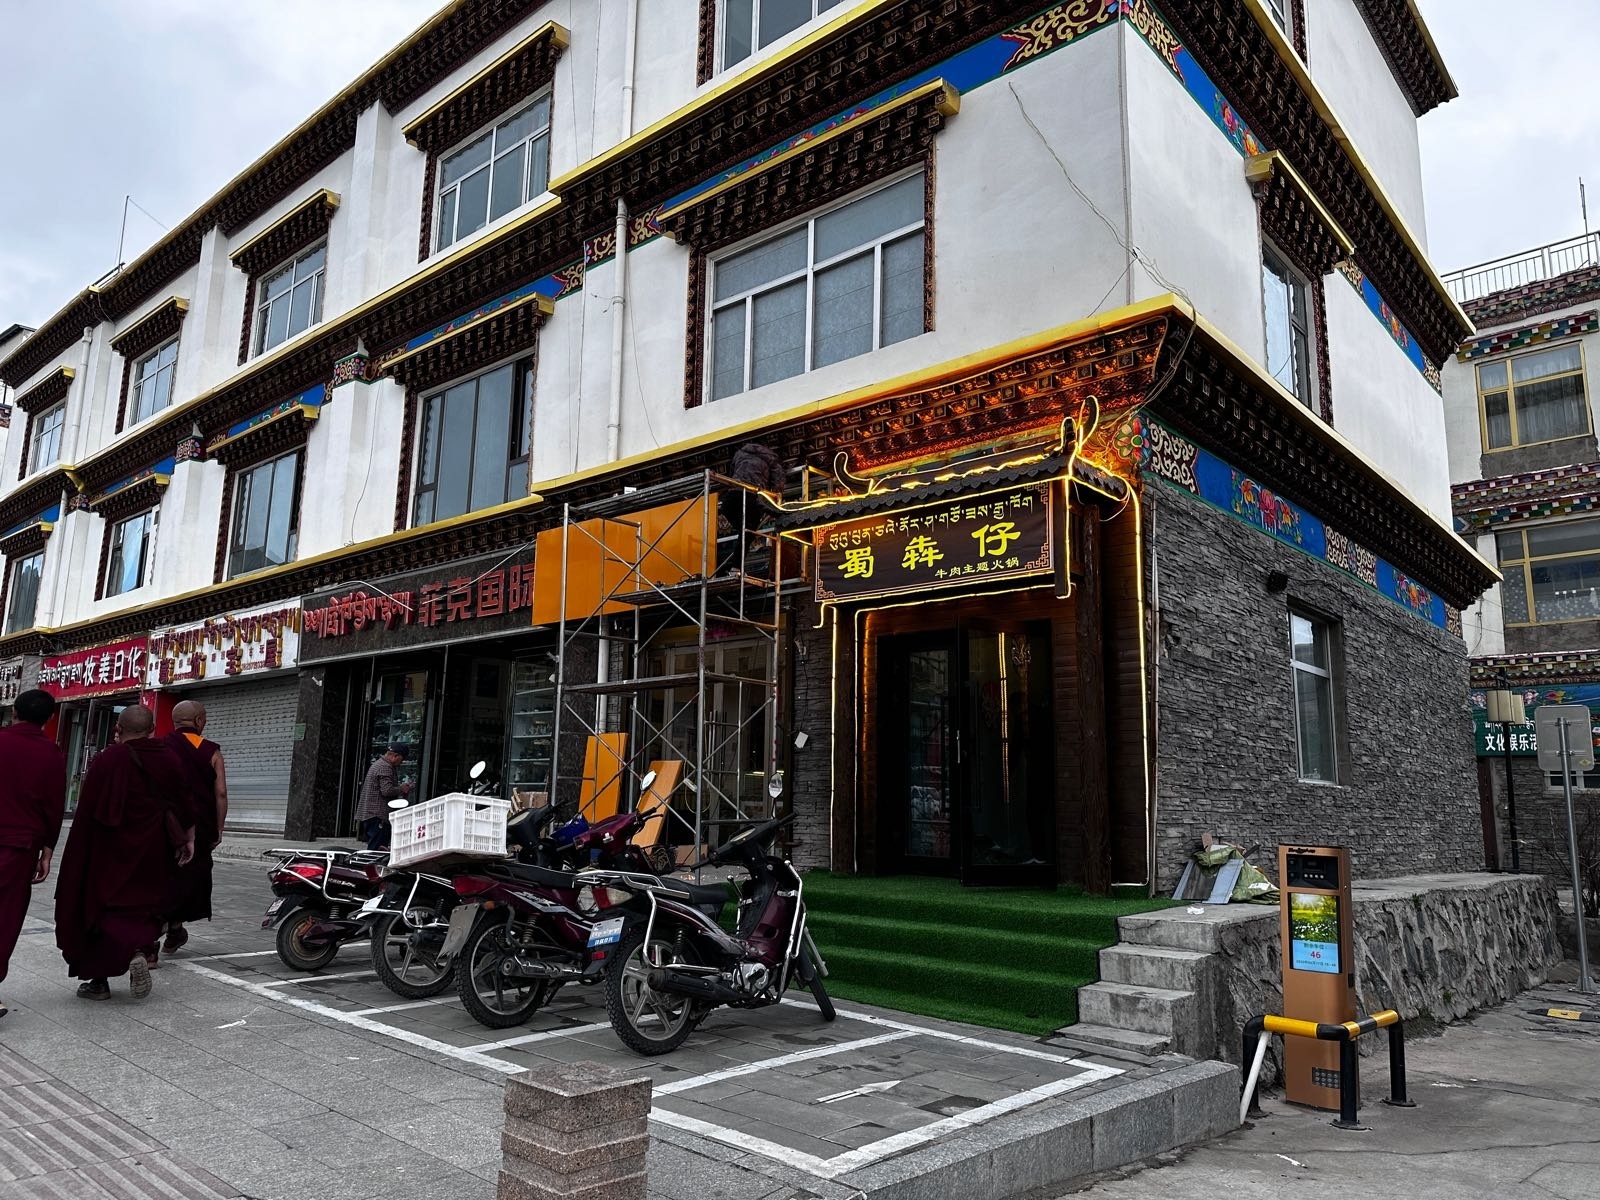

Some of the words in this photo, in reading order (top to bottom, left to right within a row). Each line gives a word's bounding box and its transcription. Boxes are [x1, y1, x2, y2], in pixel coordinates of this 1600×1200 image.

[837, 521, 1021, 579] 蜀犇仔
[934, 556, 1020, 579] 牛肉主题火锅
[418, 563, 534, 627] 菲克国际
[82, 645, 142, 687] 妆美日化
[1310, 950, 1321, 959] 46
